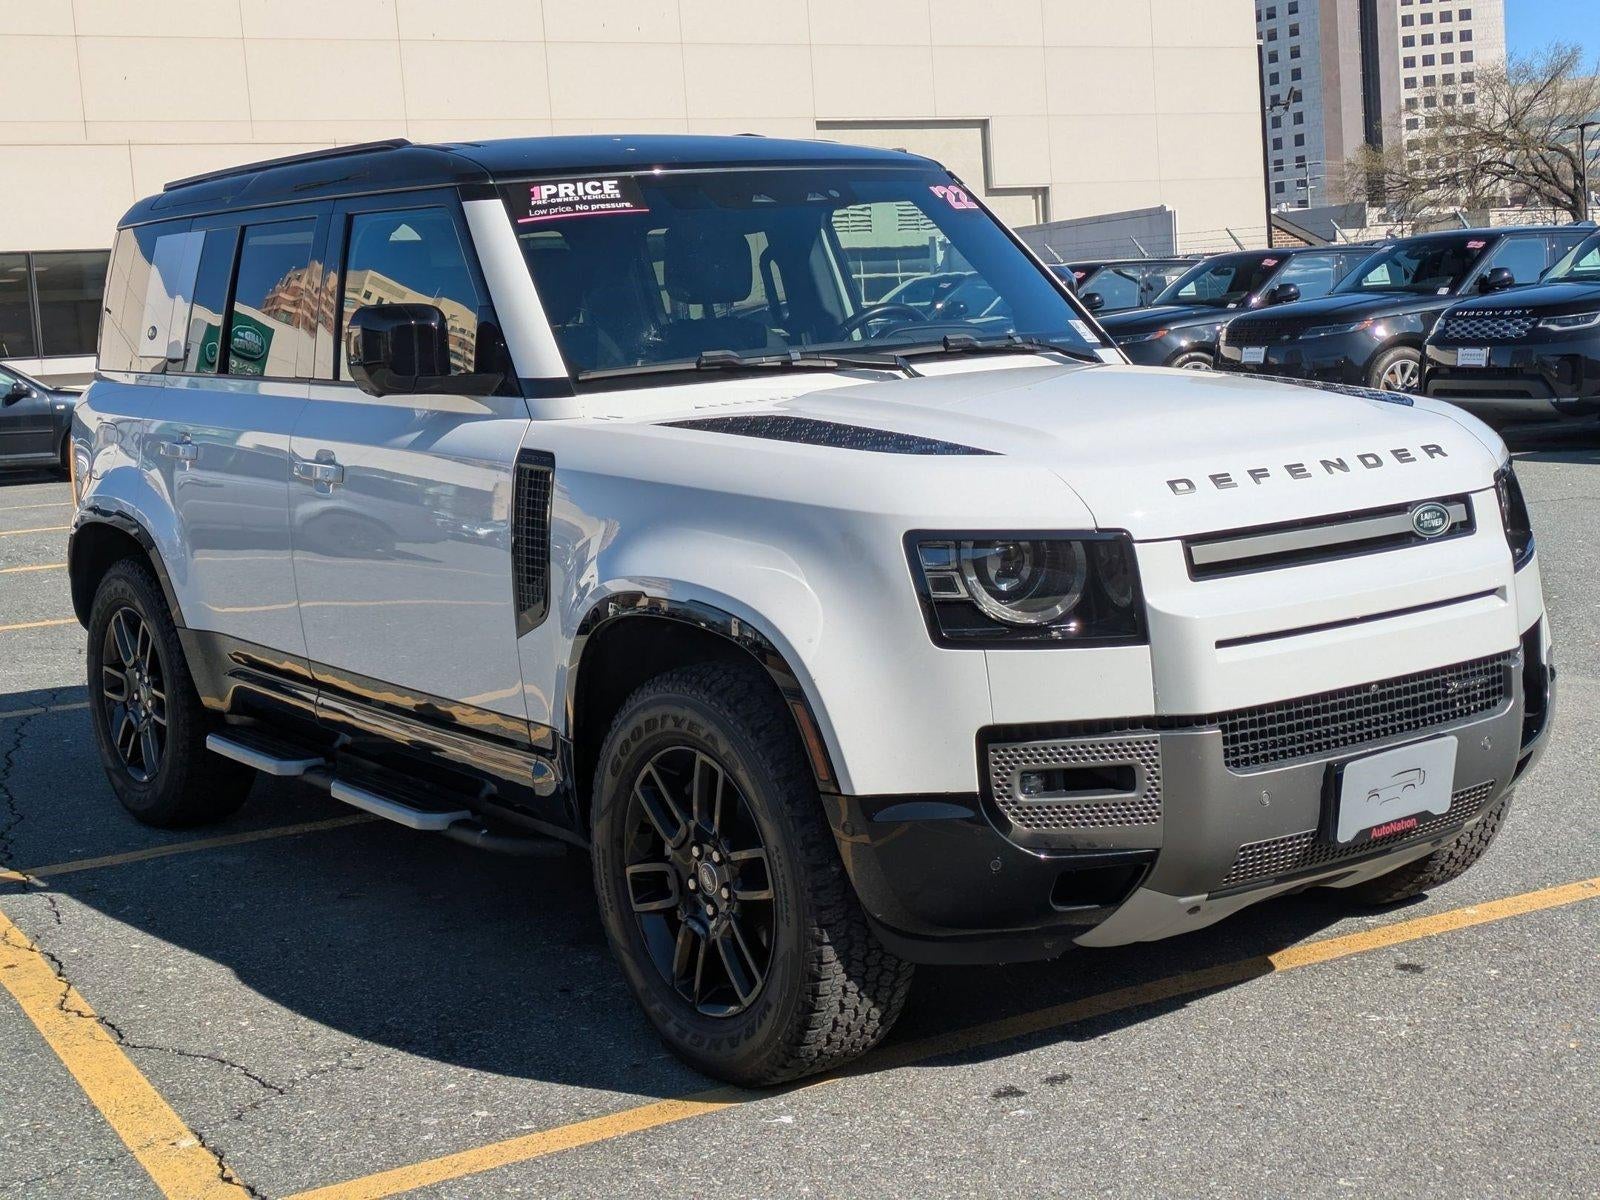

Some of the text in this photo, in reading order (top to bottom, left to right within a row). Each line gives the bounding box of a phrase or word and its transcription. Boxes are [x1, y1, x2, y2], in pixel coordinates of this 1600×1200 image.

[530, 180, 620, 201] 1PRICE
[529, 208, 548, 216] Low
[549, 206, 574, 215] price.
[591, 202, 633, 211] pressure.
[531, 197, 580, 206] PRE-OWNED
[1166, 443, 1449, 496] DEFENDER
[1420, 511, 1437, 521] LAND
[1423, 518, 1443, 528] ROVER
[610, 713, 740, 777] GOODYEAR
[1370, 818, 1418, 840] AutoNation
